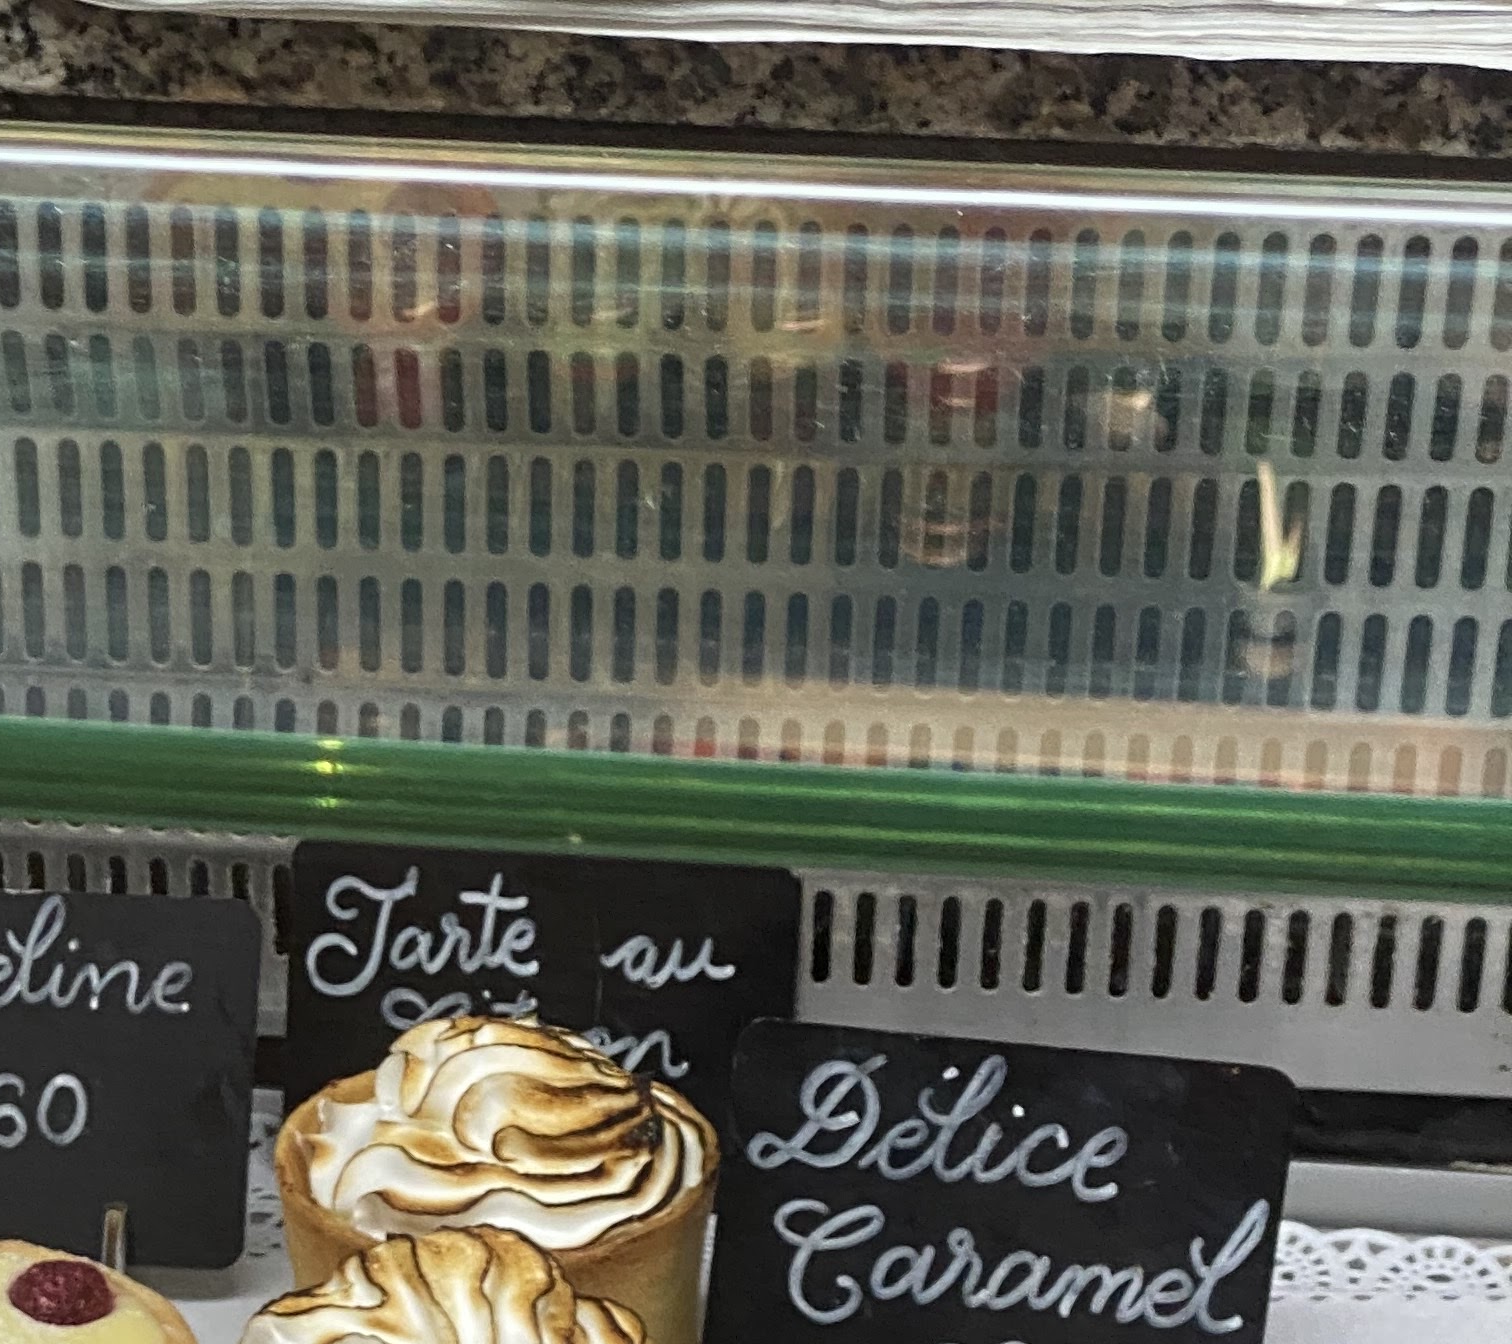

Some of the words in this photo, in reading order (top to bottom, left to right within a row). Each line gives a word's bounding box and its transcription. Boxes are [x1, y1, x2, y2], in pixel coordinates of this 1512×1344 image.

[306, 866, 539, 996] Tarte
[600, 934, 735, 988] au
[746, 1054, 1128, 1201] Délice
[773, 1199, 1270, 1335] Caramel
